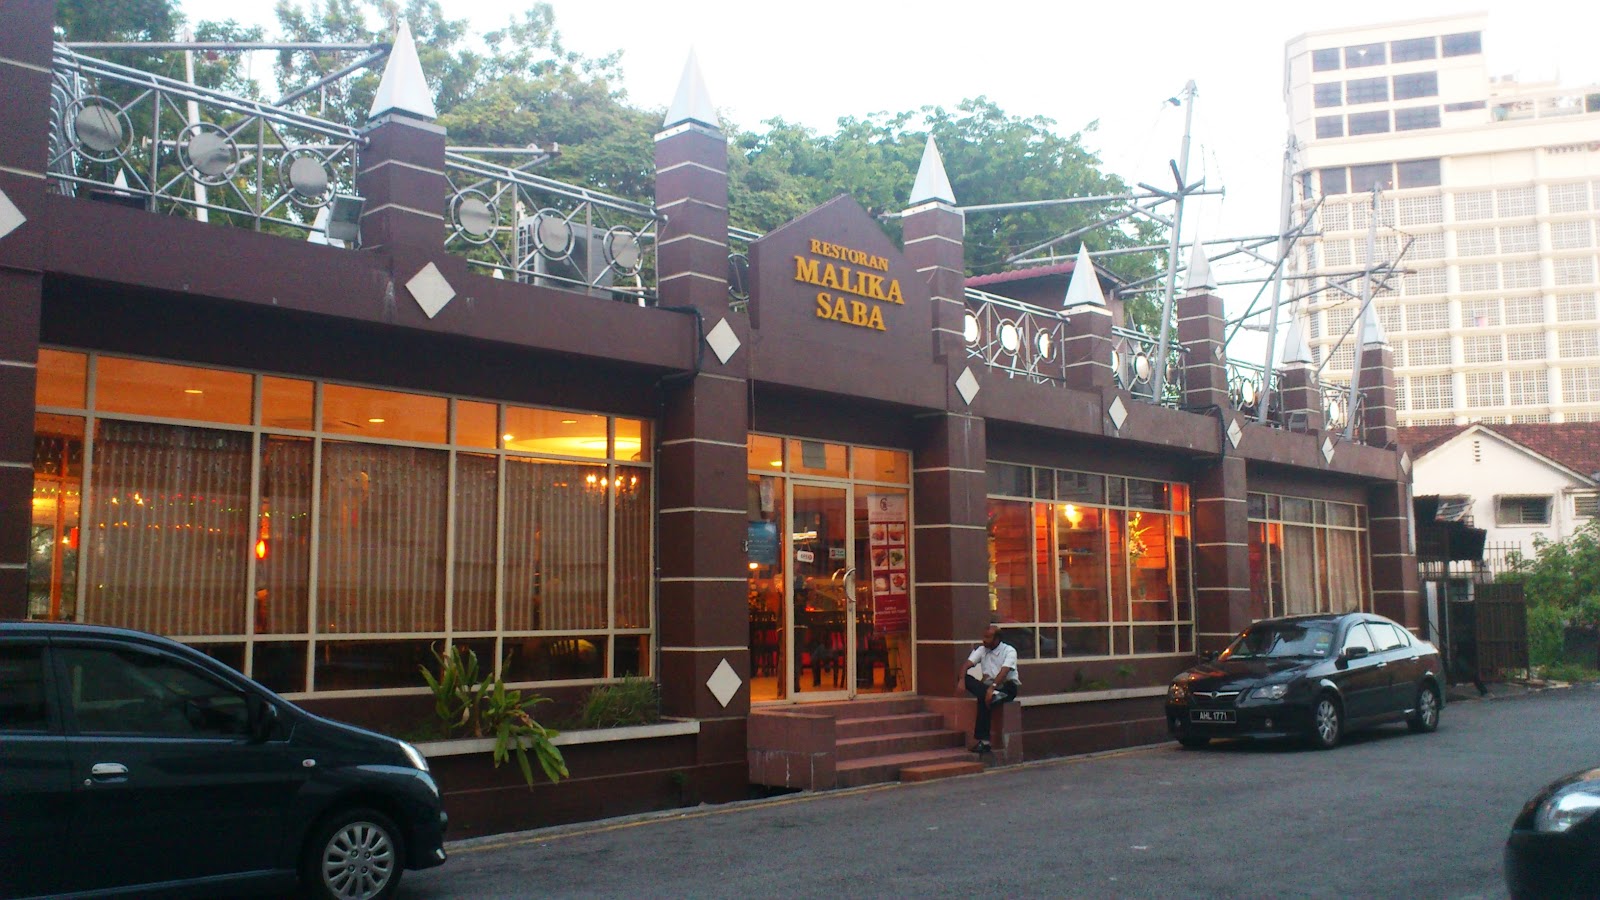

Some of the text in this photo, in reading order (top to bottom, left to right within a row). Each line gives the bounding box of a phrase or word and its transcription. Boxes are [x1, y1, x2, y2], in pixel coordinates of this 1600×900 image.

[810, 238, 889, 272] RESTORAN
[794, 255, 905, 305] MALIKA
[816, 291, 887, 331] SABA
[1199, 711, 1227, 720] AHL 1771
